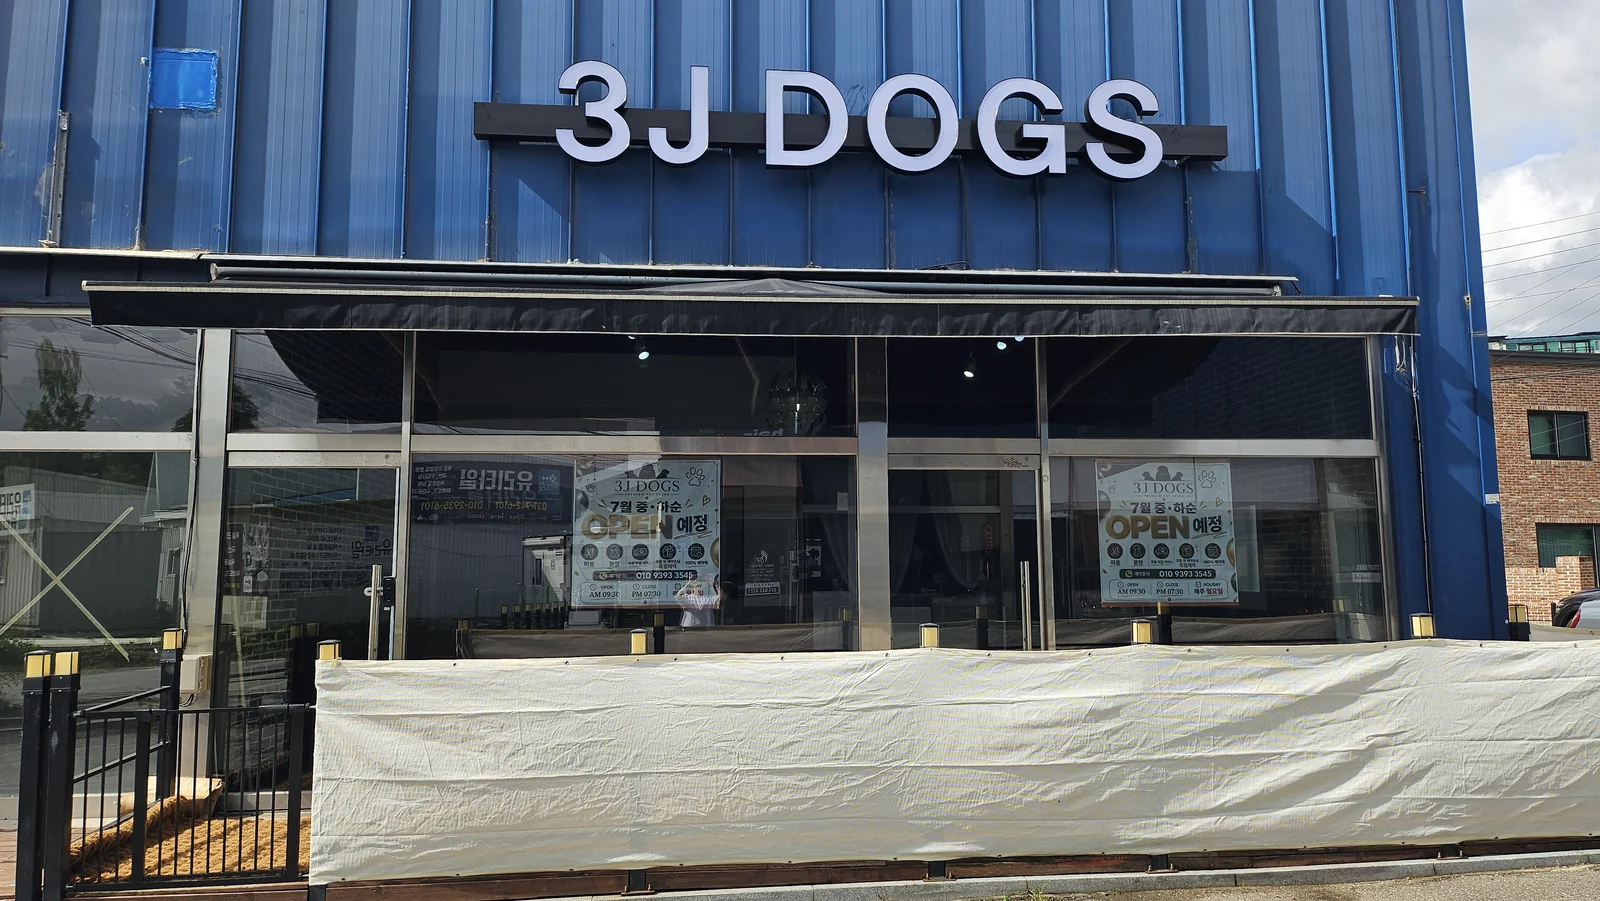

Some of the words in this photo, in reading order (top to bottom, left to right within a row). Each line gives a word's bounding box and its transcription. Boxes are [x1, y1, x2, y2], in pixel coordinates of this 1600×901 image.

[555, 60, 709, 165] 3J
[765, 69, 1163, 179] DOGS
[615, 480, 630, 492] 3J
[636, 480, 680, 492] DOGS
[1134, 482, 1147, 493] 3J
[1154, 482, 1193, 493] DOGS
[611, 501, 632, 513] 7월
[1130, 502, 1151, 514] 7월
[1155, 502, 1196, 514] 중·하순
[582, 514, 673, 539] OPEN
[677, 514, 708, 533] 예정
[1106, 515, 1190, 539] OPEN
[1193, 515, 1222, 533] 예정
